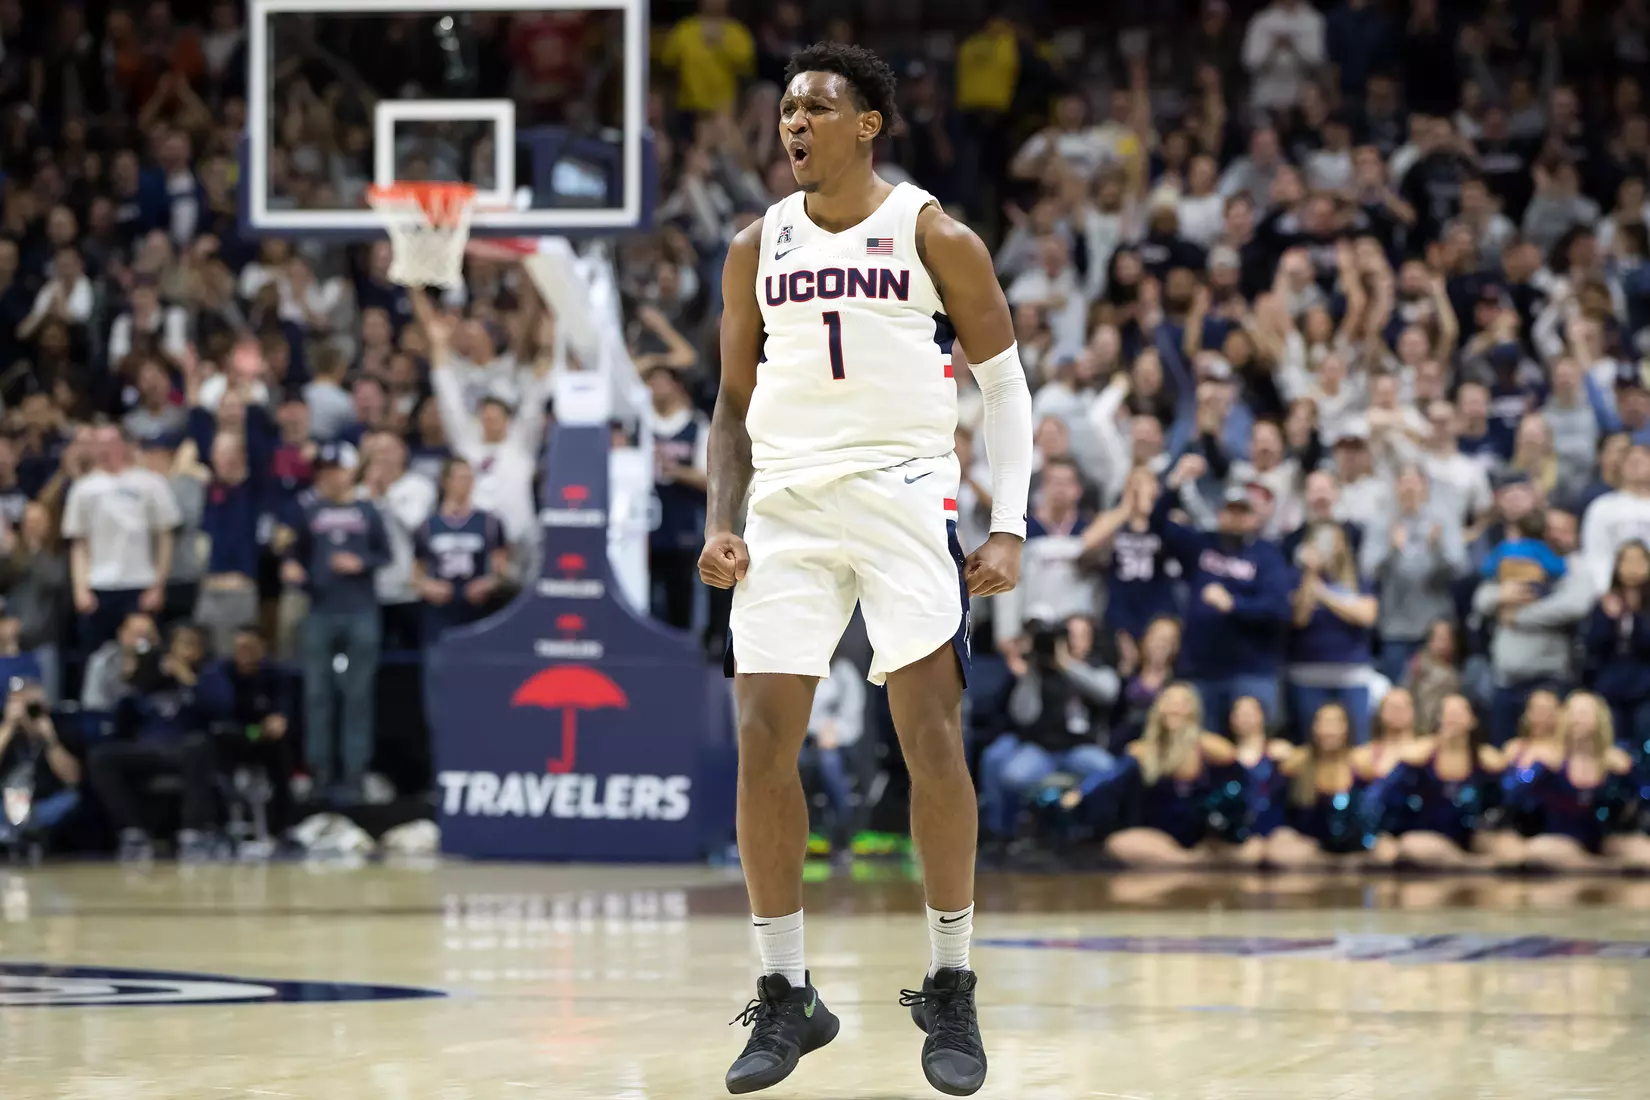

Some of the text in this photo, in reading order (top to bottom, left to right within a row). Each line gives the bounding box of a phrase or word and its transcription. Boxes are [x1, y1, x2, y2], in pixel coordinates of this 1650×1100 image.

[765, 267, 910, 307] UCONN
[822, 311, 846, 380] 1
[438, 770, 692, 821] TRAVELERS
